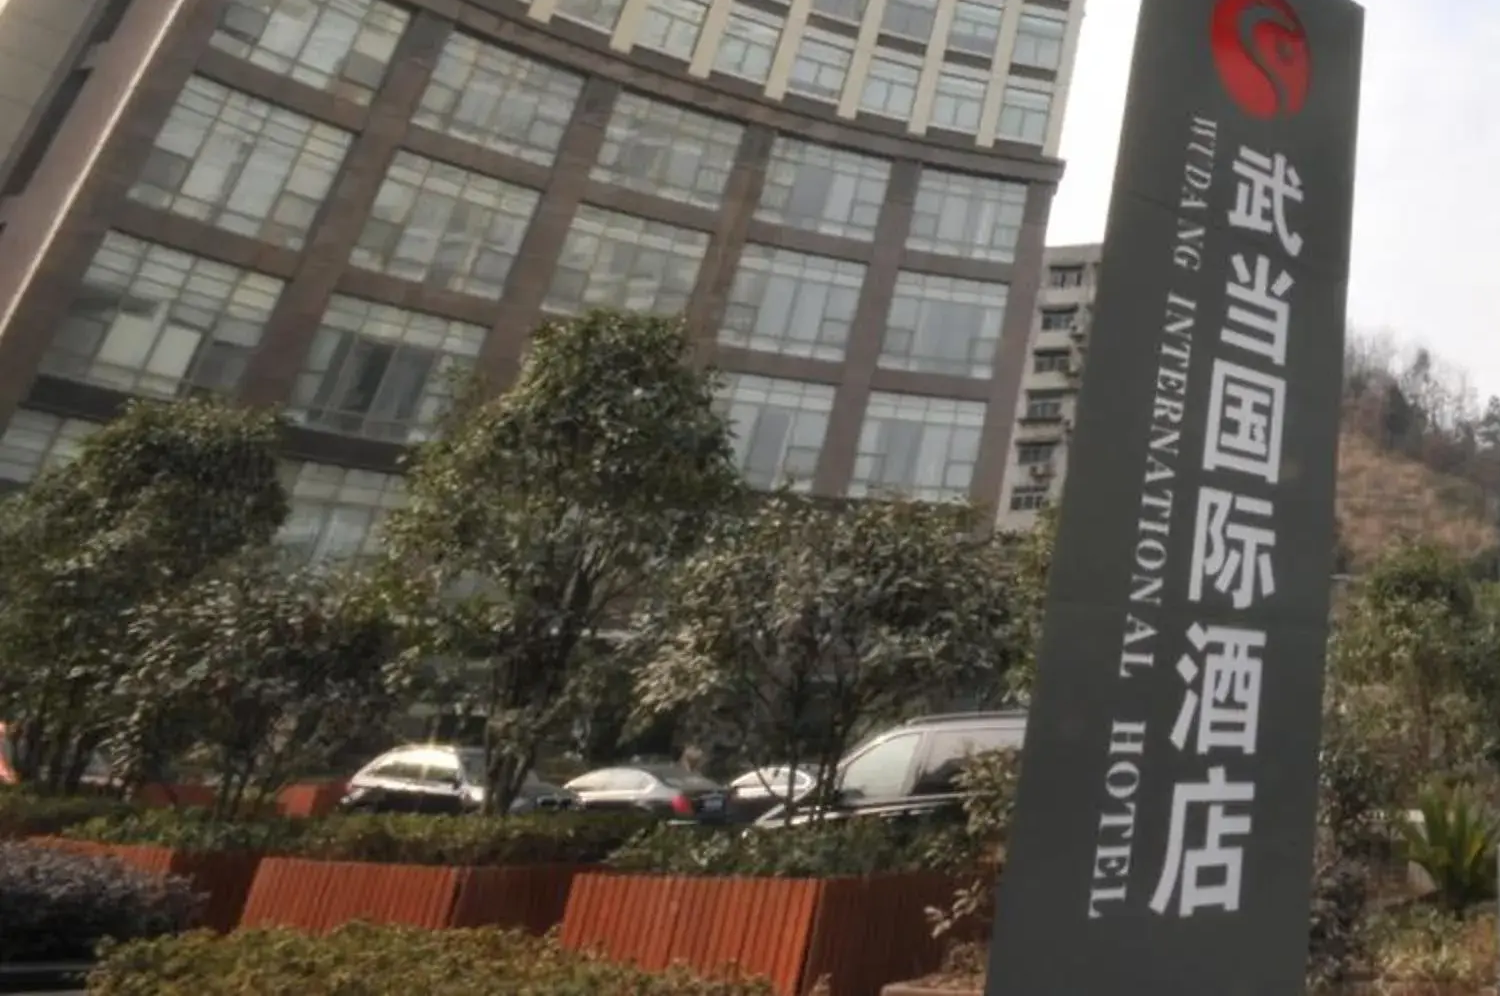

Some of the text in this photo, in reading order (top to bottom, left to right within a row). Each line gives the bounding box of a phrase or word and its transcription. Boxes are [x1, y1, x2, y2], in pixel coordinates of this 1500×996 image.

[1088, 116, 1218, 918] WUDANG INTERNATIONAL HOTEL
[1149, 144, 1304, 917] 武当国际酒店
